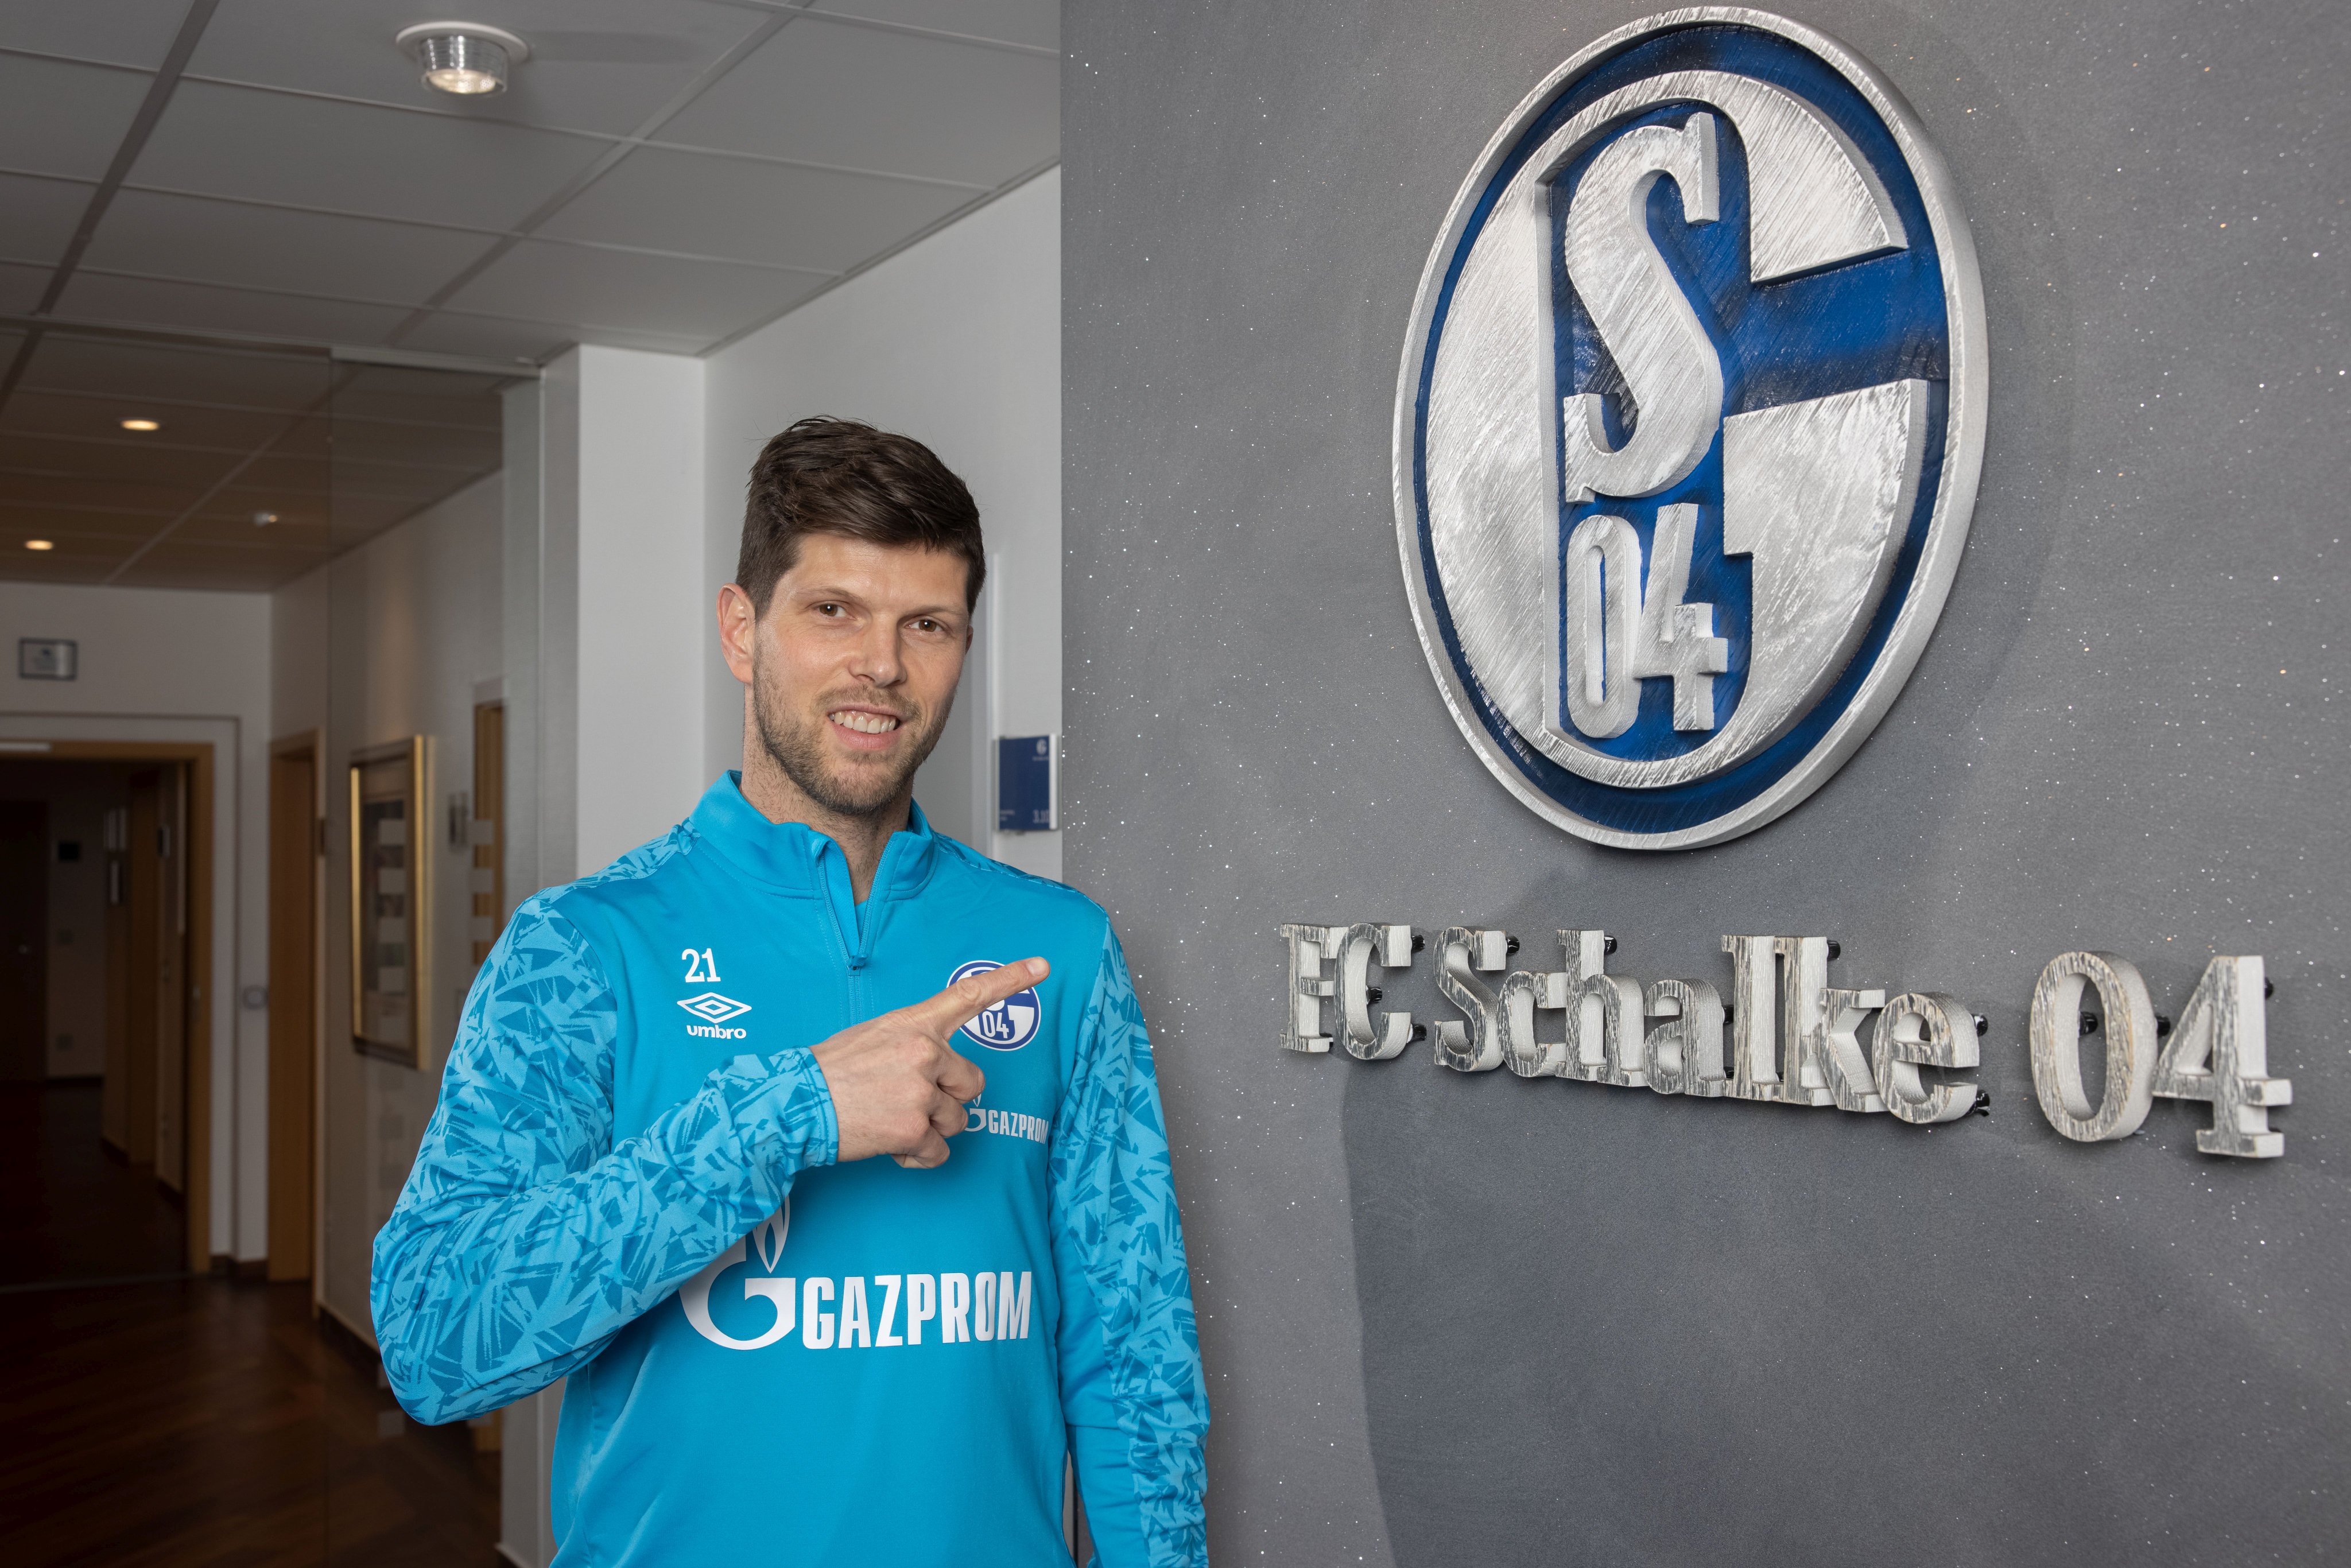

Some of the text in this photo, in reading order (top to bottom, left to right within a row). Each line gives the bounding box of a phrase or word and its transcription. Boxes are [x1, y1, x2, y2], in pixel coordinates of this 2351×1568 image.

[1564, 112, 1724, 504] S
[1566, 503, 1728, 739] 04
[681, 948, 721, 983] 21
[686, 1024, 747, 1040] umbro
[981, 1011, 1010, 1039] 04
[1281, 922, 2294, 1159] FC Schalke 04
[988, 1109, 1049, 1145] GAZPROM
[803, 1271, 1032, 1350] GAZPROM
